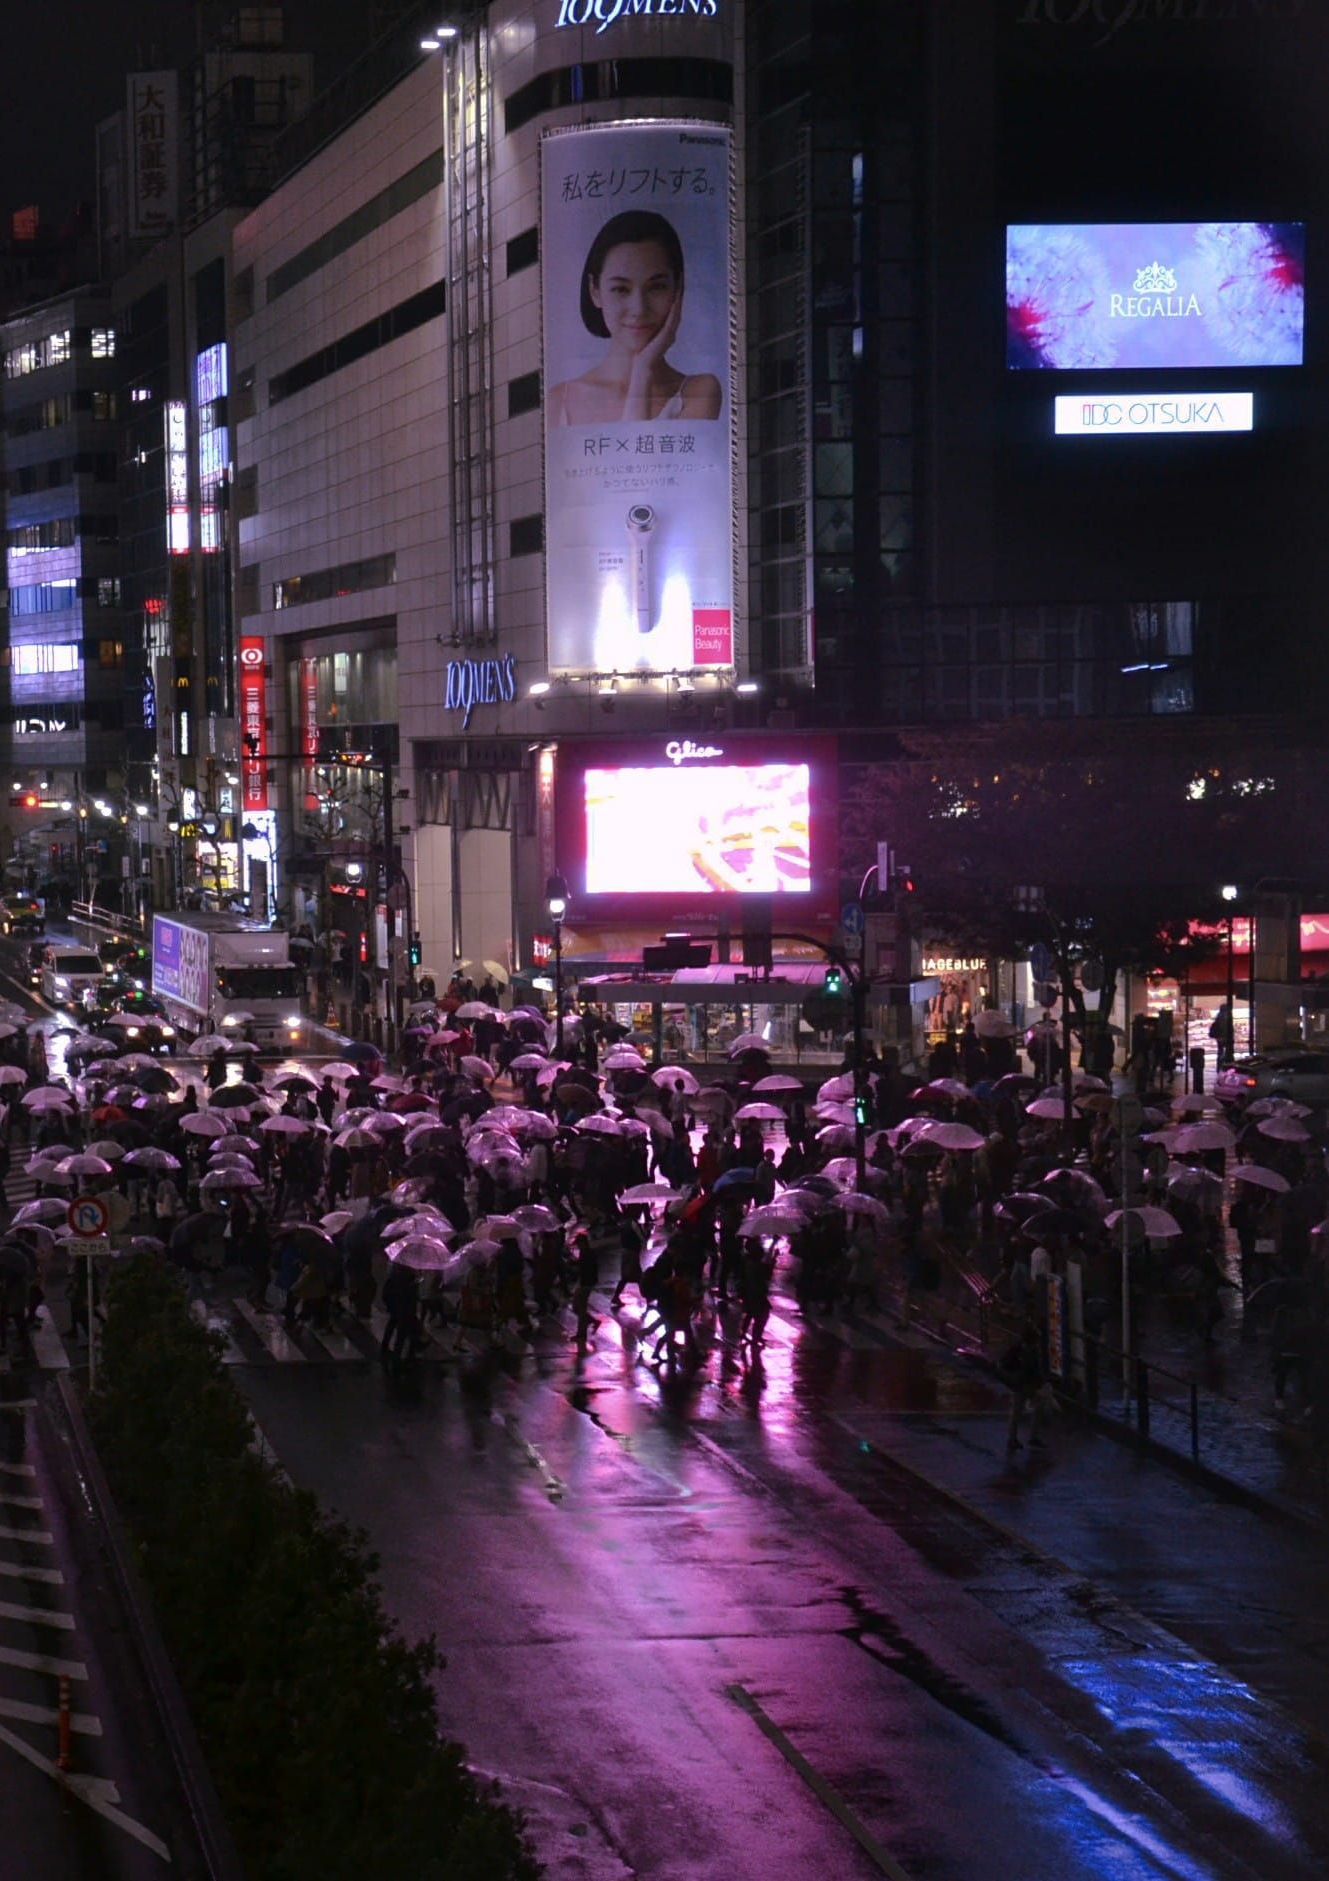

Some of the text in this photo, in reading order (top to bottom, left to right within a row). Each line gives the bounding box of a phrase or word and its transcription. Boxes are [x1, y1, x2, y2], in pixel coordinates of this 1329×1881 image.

[136, 84, 169, 199] 大和証券
[679, 134, 726, 146] Panasonic
[562, 167, 716, 199] 私をリフトする。
[1110, 294, 1203, 318] REGALIA
[1082, 401, 1225, 426] IDC OTSUKA
[695, 624, 729, 636] Panasonic
[695, 638, 723, 652] Beauty
[665, 740, 724, 765] Glico
